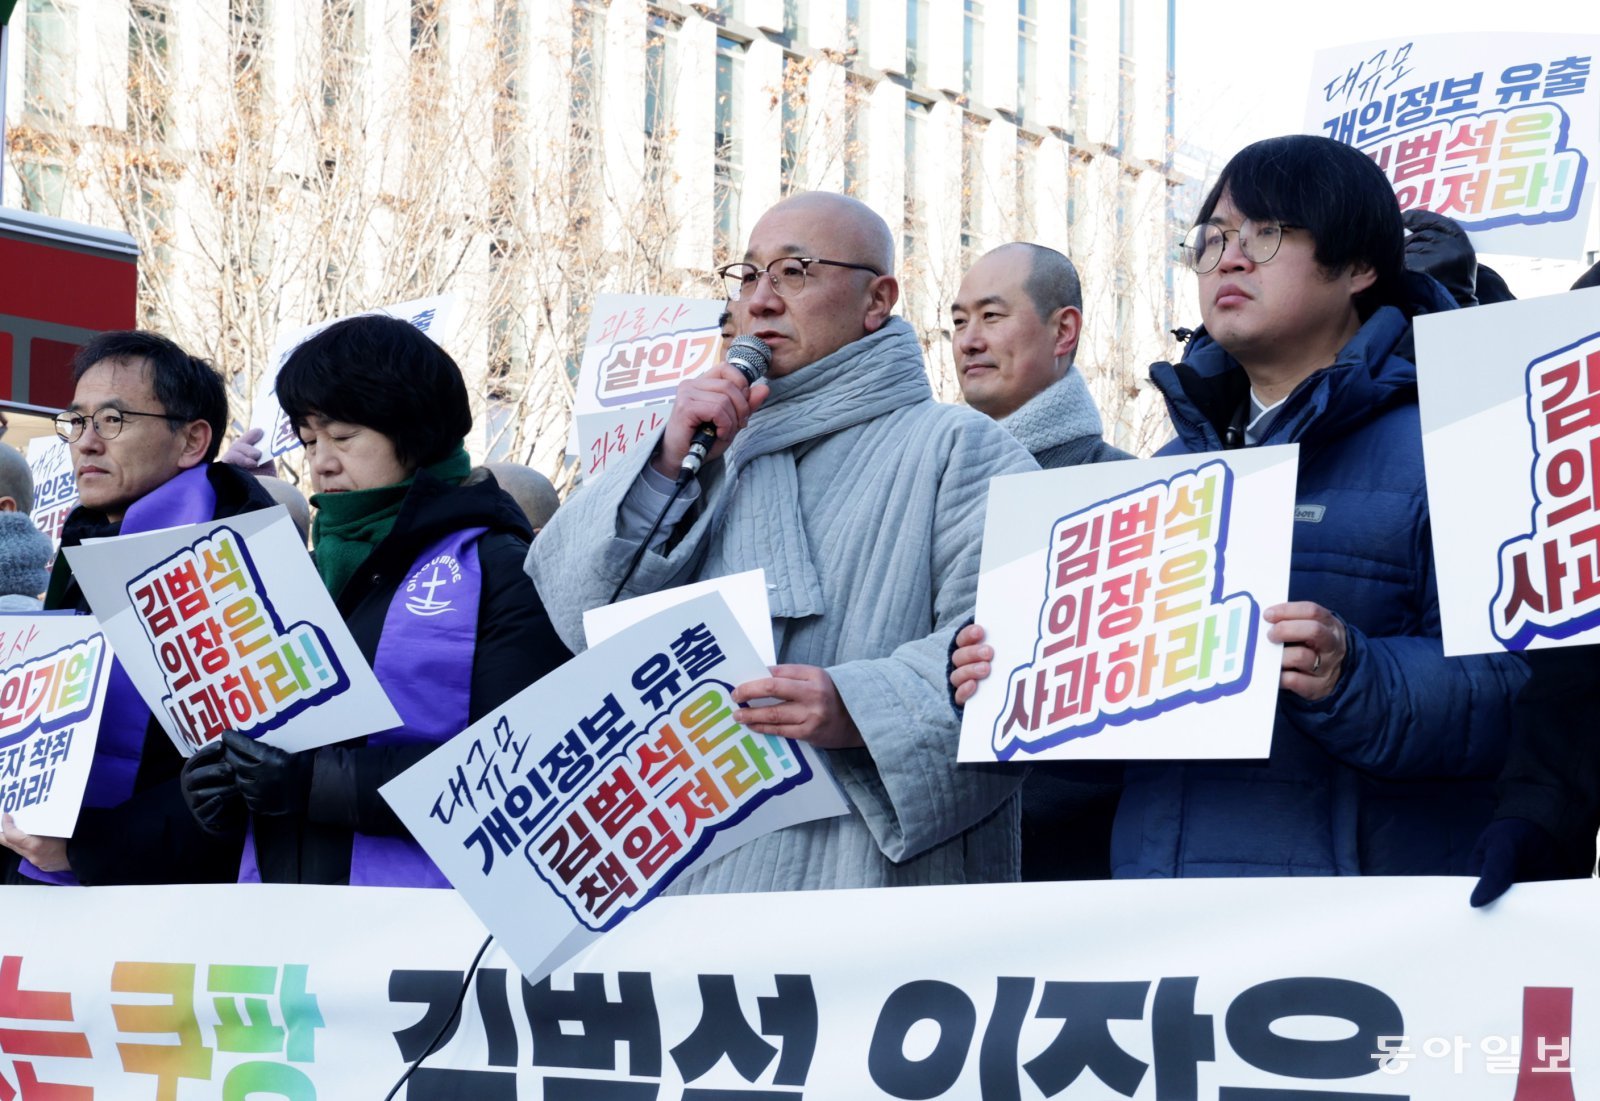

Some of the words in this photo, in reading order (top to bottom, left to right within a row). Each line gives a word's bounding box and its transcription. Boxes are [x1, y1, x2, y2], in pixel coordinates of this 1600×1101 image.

[1322, 71, 1484, 146] 개인정보
[1495, 56, 1592, 105] 유출
[1323, 42, 1416, 103] 대규모
[596, 303, 691, 343] 과로사
[604, 334, 722, 392] 살인기
[589, 412, 664, 474] 과로사
[1056, 475, 1217, 588] 김범석
[135, 538, 247, 638] 김범석
[1043, 549, 1208, 659] 의장은
[161, 596, 272, 692] 의장은
[170, 632, 330, 746] 사과하라!
[1001, 607, 1242, 739] 사과하라!
[29, 728, 74, 770] 착취
[430, 715, 531, 825] 대규모
[463, 693, 636, 876] 개인정보
[631, 622, 727, 710] 유출
[538, 689, 736, 886] 김범석은
[576, 734, 792, 919] 책임져라!
